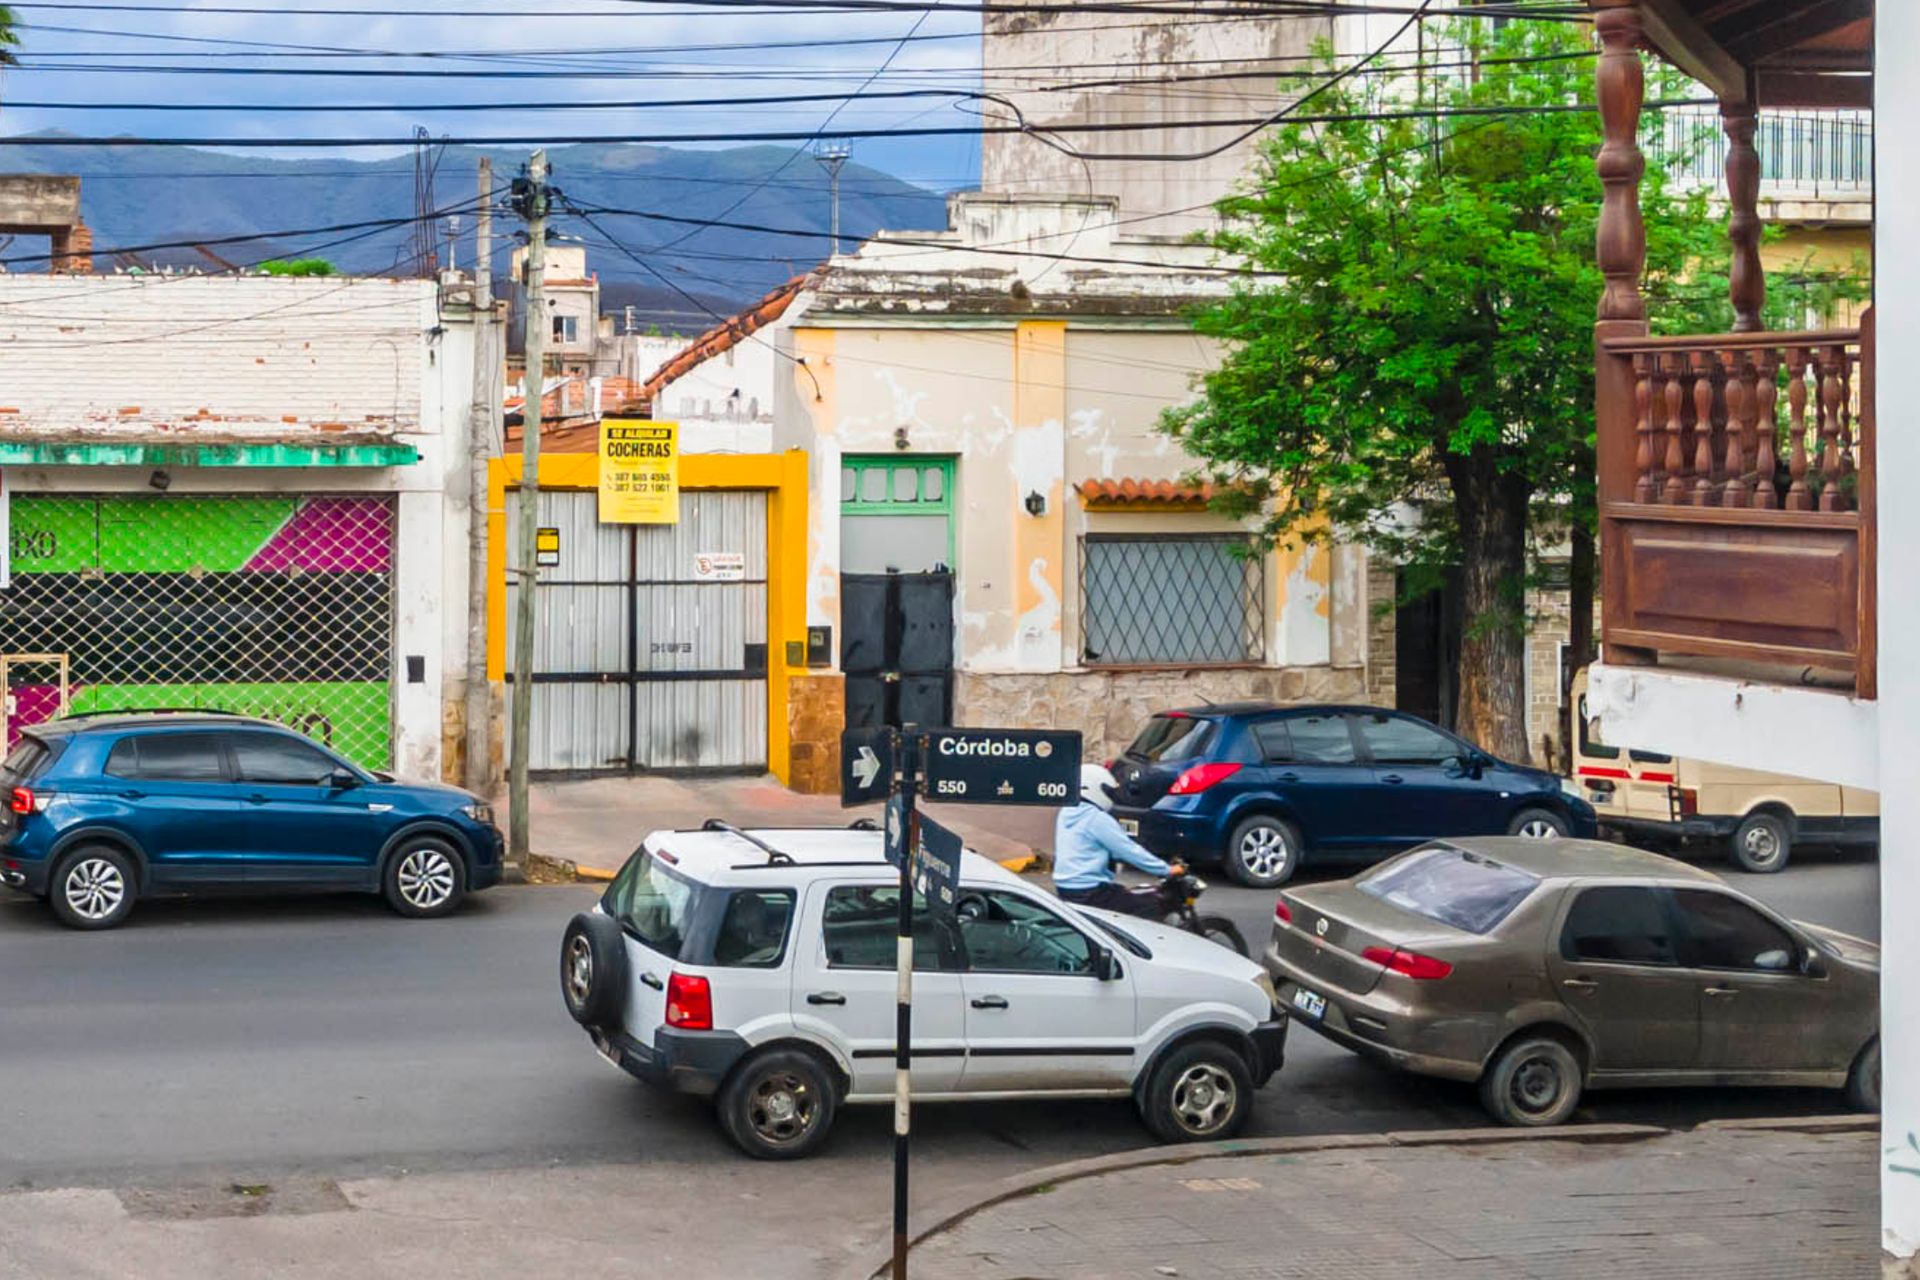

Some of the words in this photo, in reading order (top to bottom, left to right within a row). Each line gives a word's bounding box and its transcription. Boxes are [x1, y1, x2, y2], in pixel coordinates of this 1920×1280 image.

[607, 442, 670, 457] COCHERAS
[939, 736, 1029, 756] Córdoba
[938, 780, 966, 794] 550
[1038, 783, 1067, 796] 600
